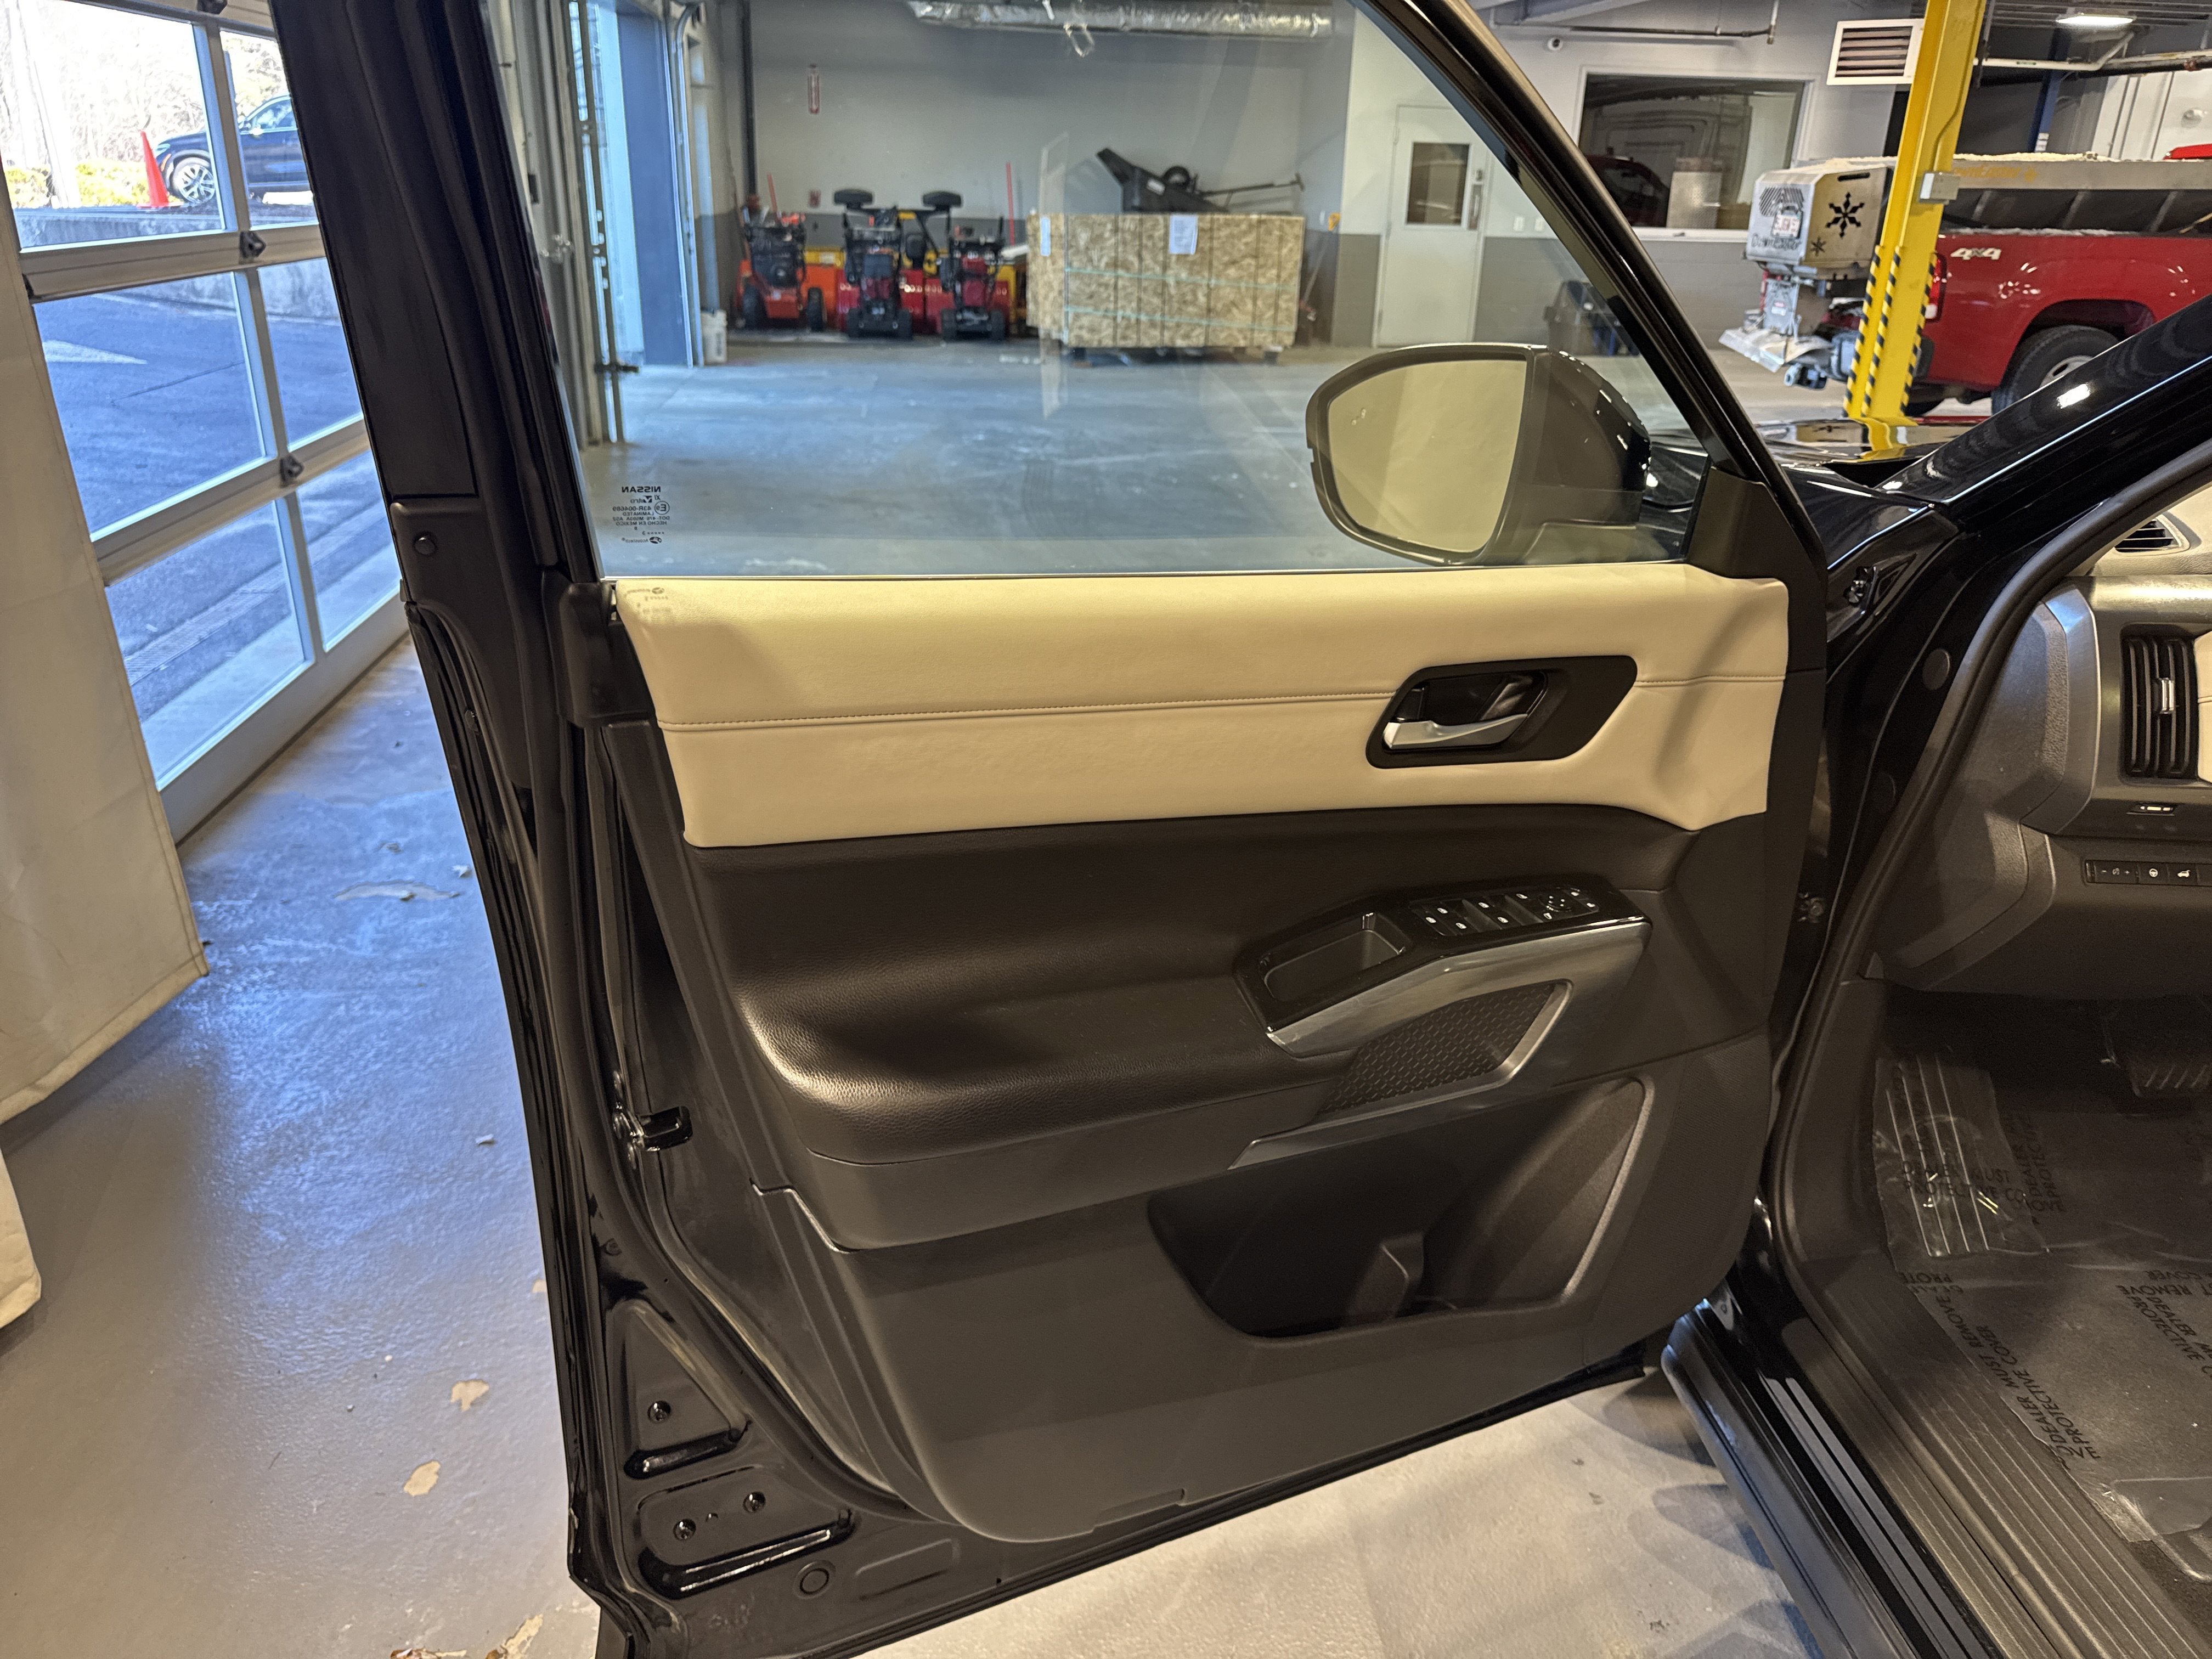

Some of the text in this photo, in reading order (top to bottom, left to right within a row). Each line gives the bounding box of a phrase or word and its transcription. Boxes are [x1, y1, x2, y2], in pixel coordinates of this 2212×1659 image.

[2115, 1284, 2193, 1295] REMOVE
[2143, 1269, 2203, 1280] COVER
[2126, 1296, 2205, 1361] PROTECTIVE
[2146, 1297, 2197, 1336] DEALER
[1936, 1295, 2067, 1444] DEALER MUST REMOVE
[1976, 1325, 2090, 1444] PROTECTIVE COVER
